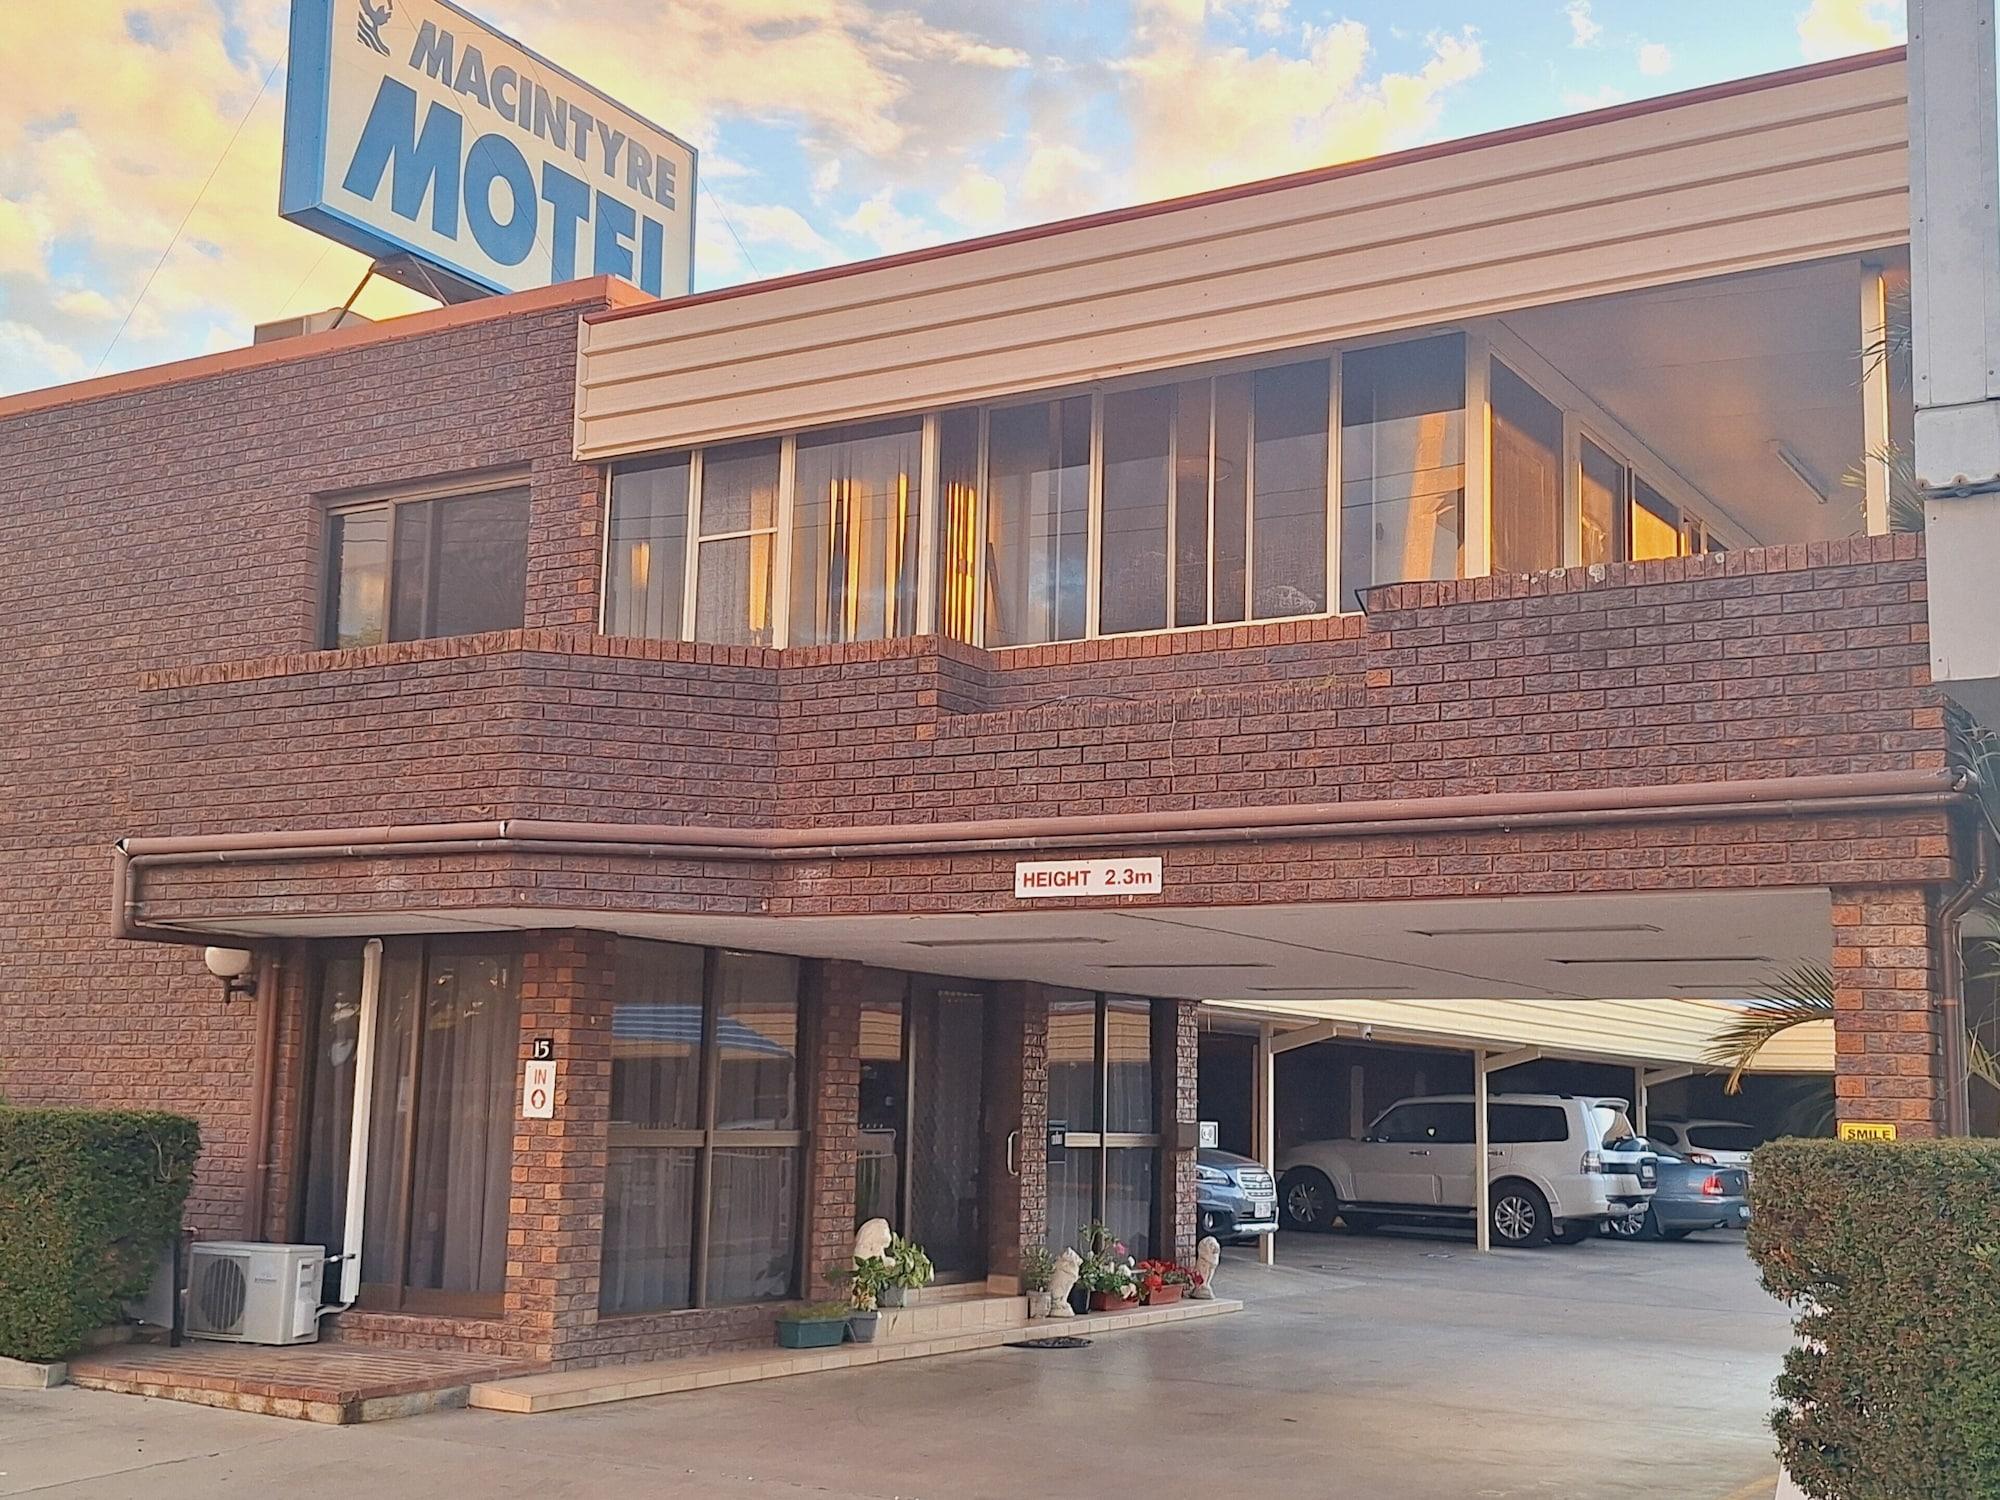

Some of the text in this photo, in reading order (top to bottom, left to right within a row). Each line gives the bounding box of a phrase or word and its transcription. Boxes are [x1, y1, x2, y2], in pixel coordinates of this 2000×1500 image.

[409, 19, 676, 211] MACINTYRE
[1023, 868, 1153, 888] HEIGHT 2.3m
[534, 1040, 550, 1059] 15
[534, 1068, 547, 1085] IN
[1847, 1128, 1891, 1139] SMILE
